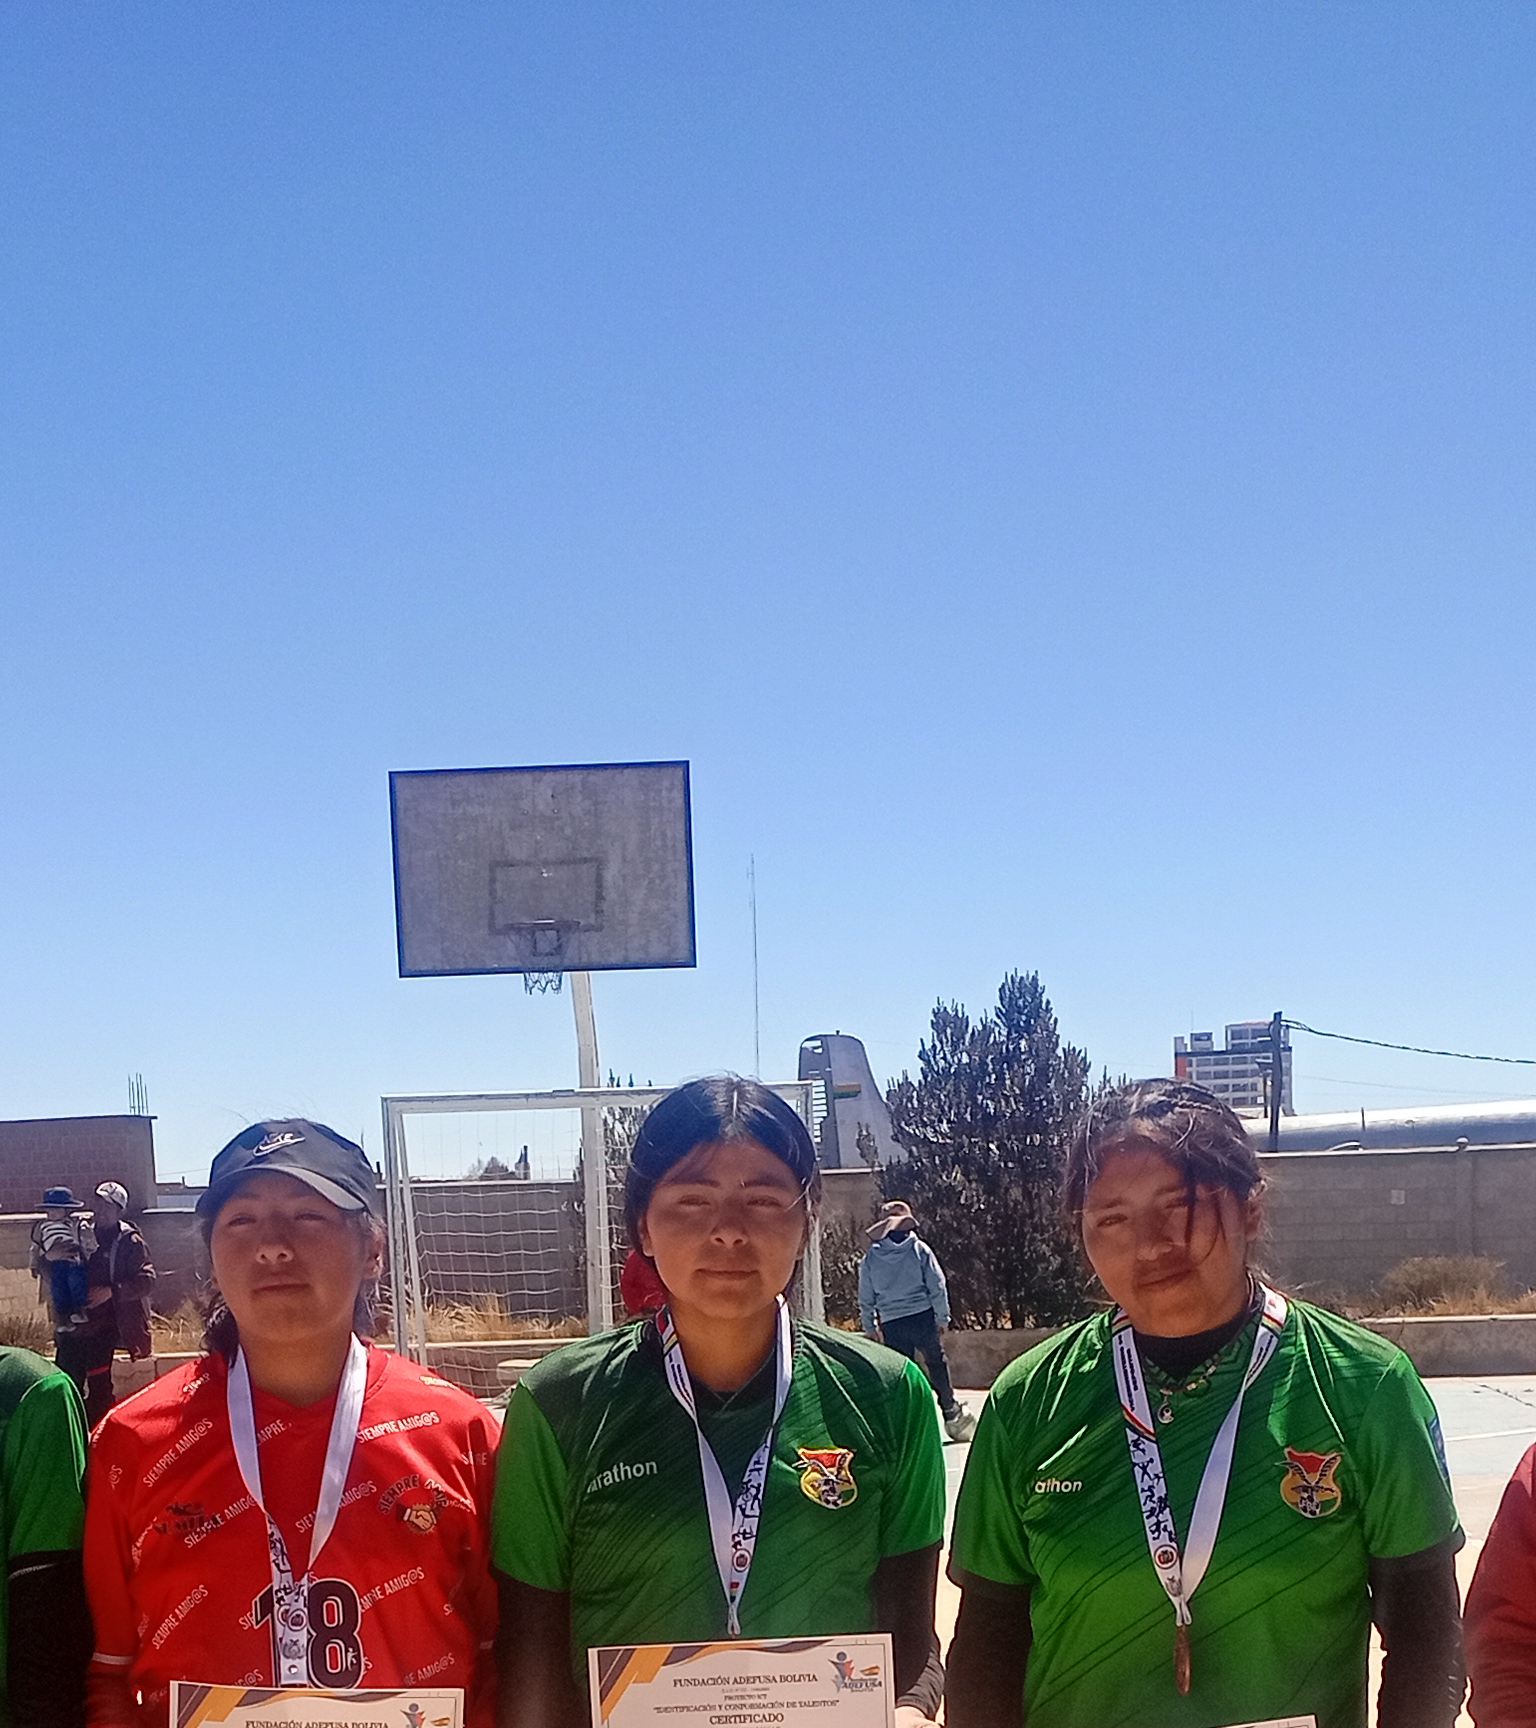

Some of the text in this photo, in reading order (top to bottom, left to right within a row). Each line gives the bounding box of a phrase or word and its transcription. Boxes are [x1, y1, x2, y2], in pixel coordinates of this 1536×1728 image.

[356, 1411, 440, 1444] SIEMPRE AMIG@S
[143, 1448, 180, 1488] SIEMPRE
[175, 1417, 214, 1454] AMIG@S
[378, 1473, 420, 1515] SIEMPRE
[383, 1566, 426, 1597] AMIG@S
[151, 1584, 209, 1650] SIEMPRE AMIG@S
[672, 1672, 818, 1687] FUNDACIÓN ADEFUSA BOLIVIA
[245, 1718, 303, 1728] FUNDACIÓN
[708, 1712, 785, 1725] CERTIFICADO
